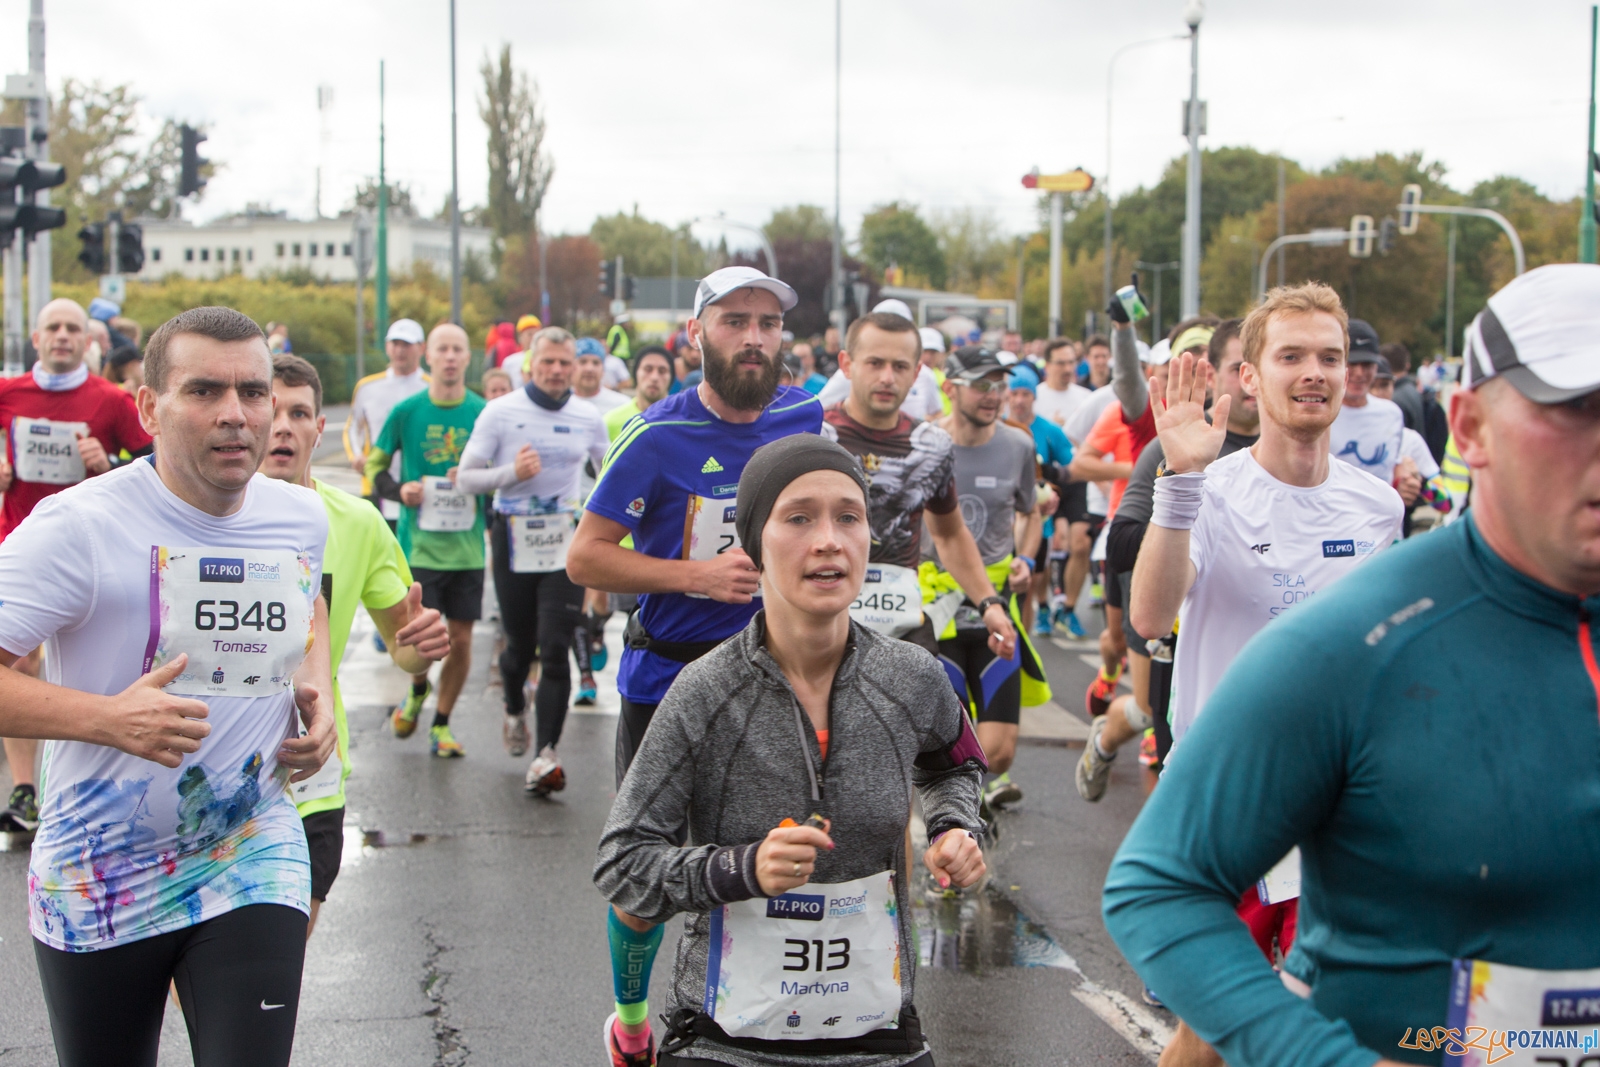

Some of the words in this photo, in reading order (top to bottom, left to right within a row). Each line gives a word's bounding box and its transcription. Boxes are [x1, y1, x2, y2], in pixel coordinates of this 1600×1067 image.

[27, 440, 72, 457] 2664
[701, 466, 724, 474] adidas
[625, 508, 644, 518] SPORT
[525, 532, 564, 548] 5644
[248, 572, 280, 580] maraton
[1272, 572, 1306, 588] SIŁA
[850, 592, 906, 612] 5462
[195, 600, 286, 632] 6348
[213, 640, 268, 654] Tomasz
[243, 676, 261, 685] 4F
[829, 903, 866, 916] maraton
[782, 938, 850, 972] 313
[622, 941, 652, 1000] kalenji
[780, 980, 850, 996] Martyna
[822, 1016, 842, 1026] 4F
